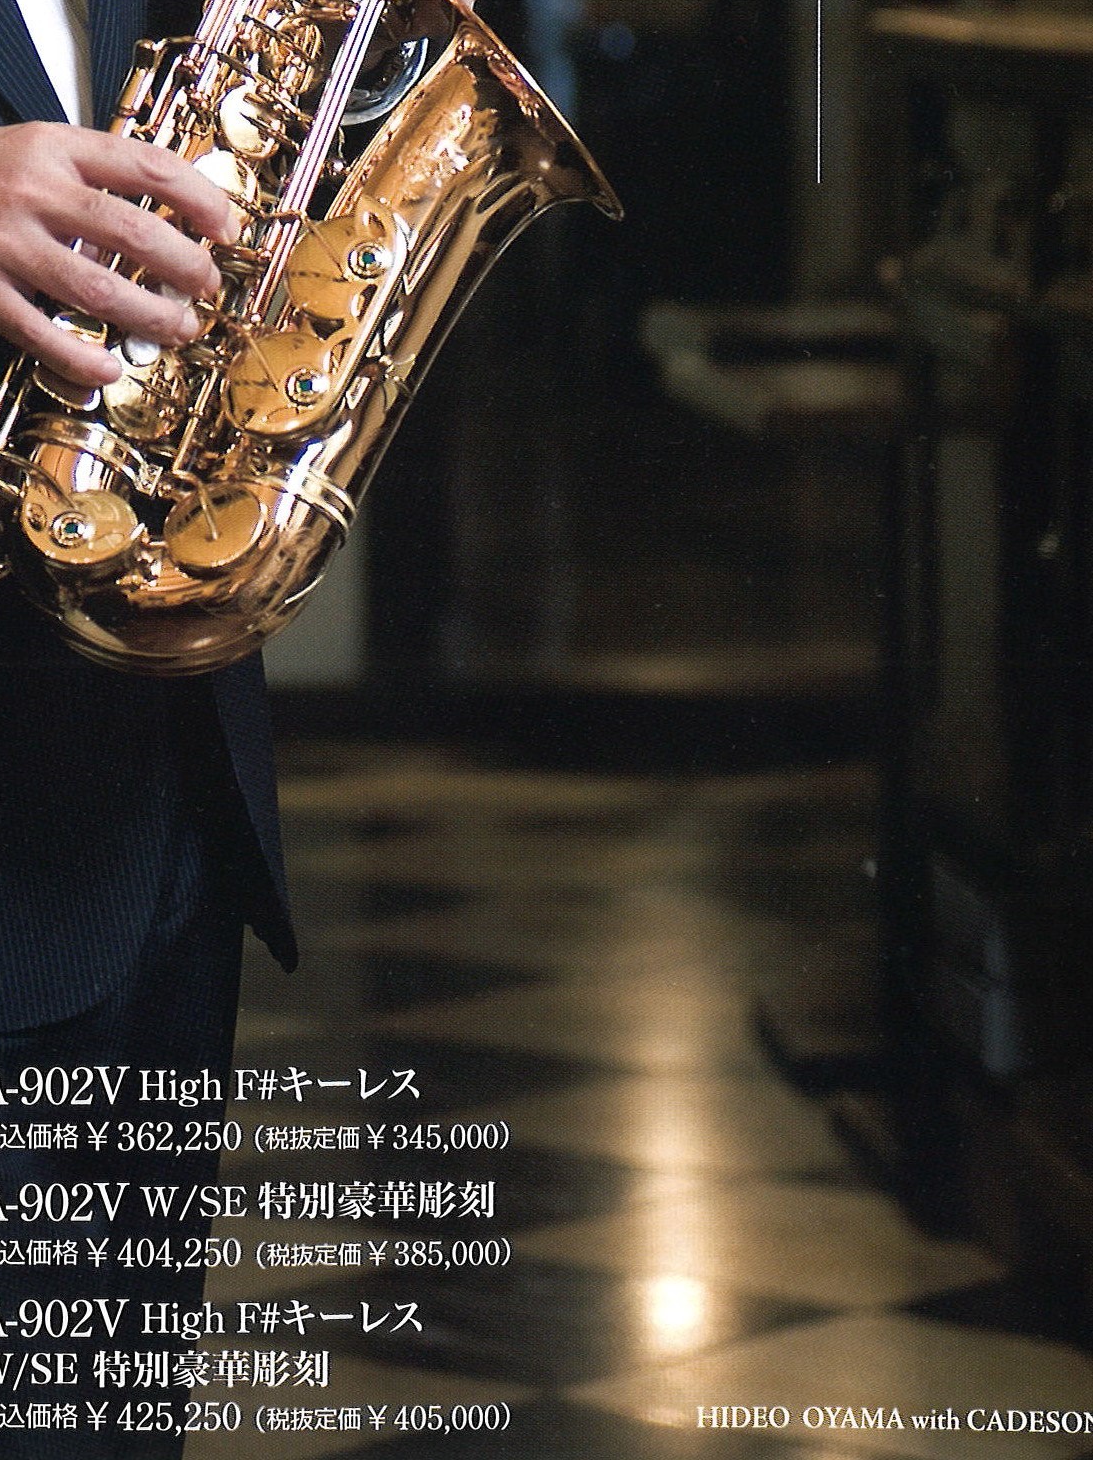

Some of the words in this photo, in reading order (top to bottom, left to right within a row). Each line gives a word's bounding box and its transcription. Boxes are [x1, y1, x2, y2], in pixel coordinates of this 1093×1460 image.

[138, 1068, 223, 1108] High
[139, 1184, 248, 1221] W/SE
[257, 1180, 495, 1220] 特別豪華彫刻
[141, 1301, 226, 1341] High
[93, 1349, 329, 1389] 特別豪華彫刻
[697, 1406, 790, 1428] HIDEO
[802, 1406, 905, 1429] OYAMA
[911, 1408, 960, 1430] with
